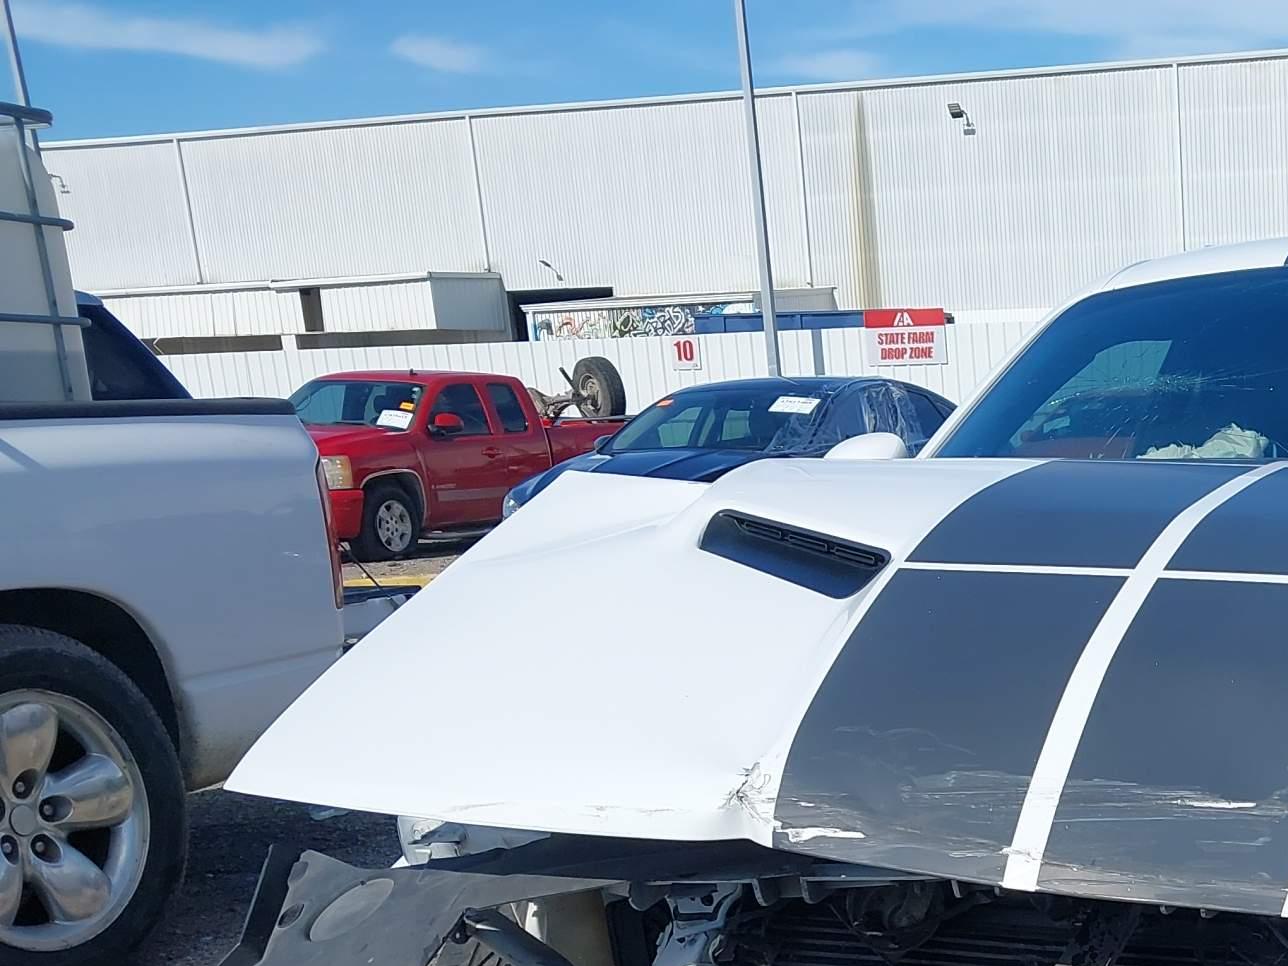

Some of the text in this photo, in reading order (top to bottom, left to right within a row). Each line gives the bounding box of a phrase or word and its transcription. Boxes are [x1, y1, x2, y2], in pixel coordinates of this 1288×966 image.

[877, 331, 934, 346] STATE FARM
[673, 340, 694, 362] 10
[881, 347, 933, 360] DROP ZONE
